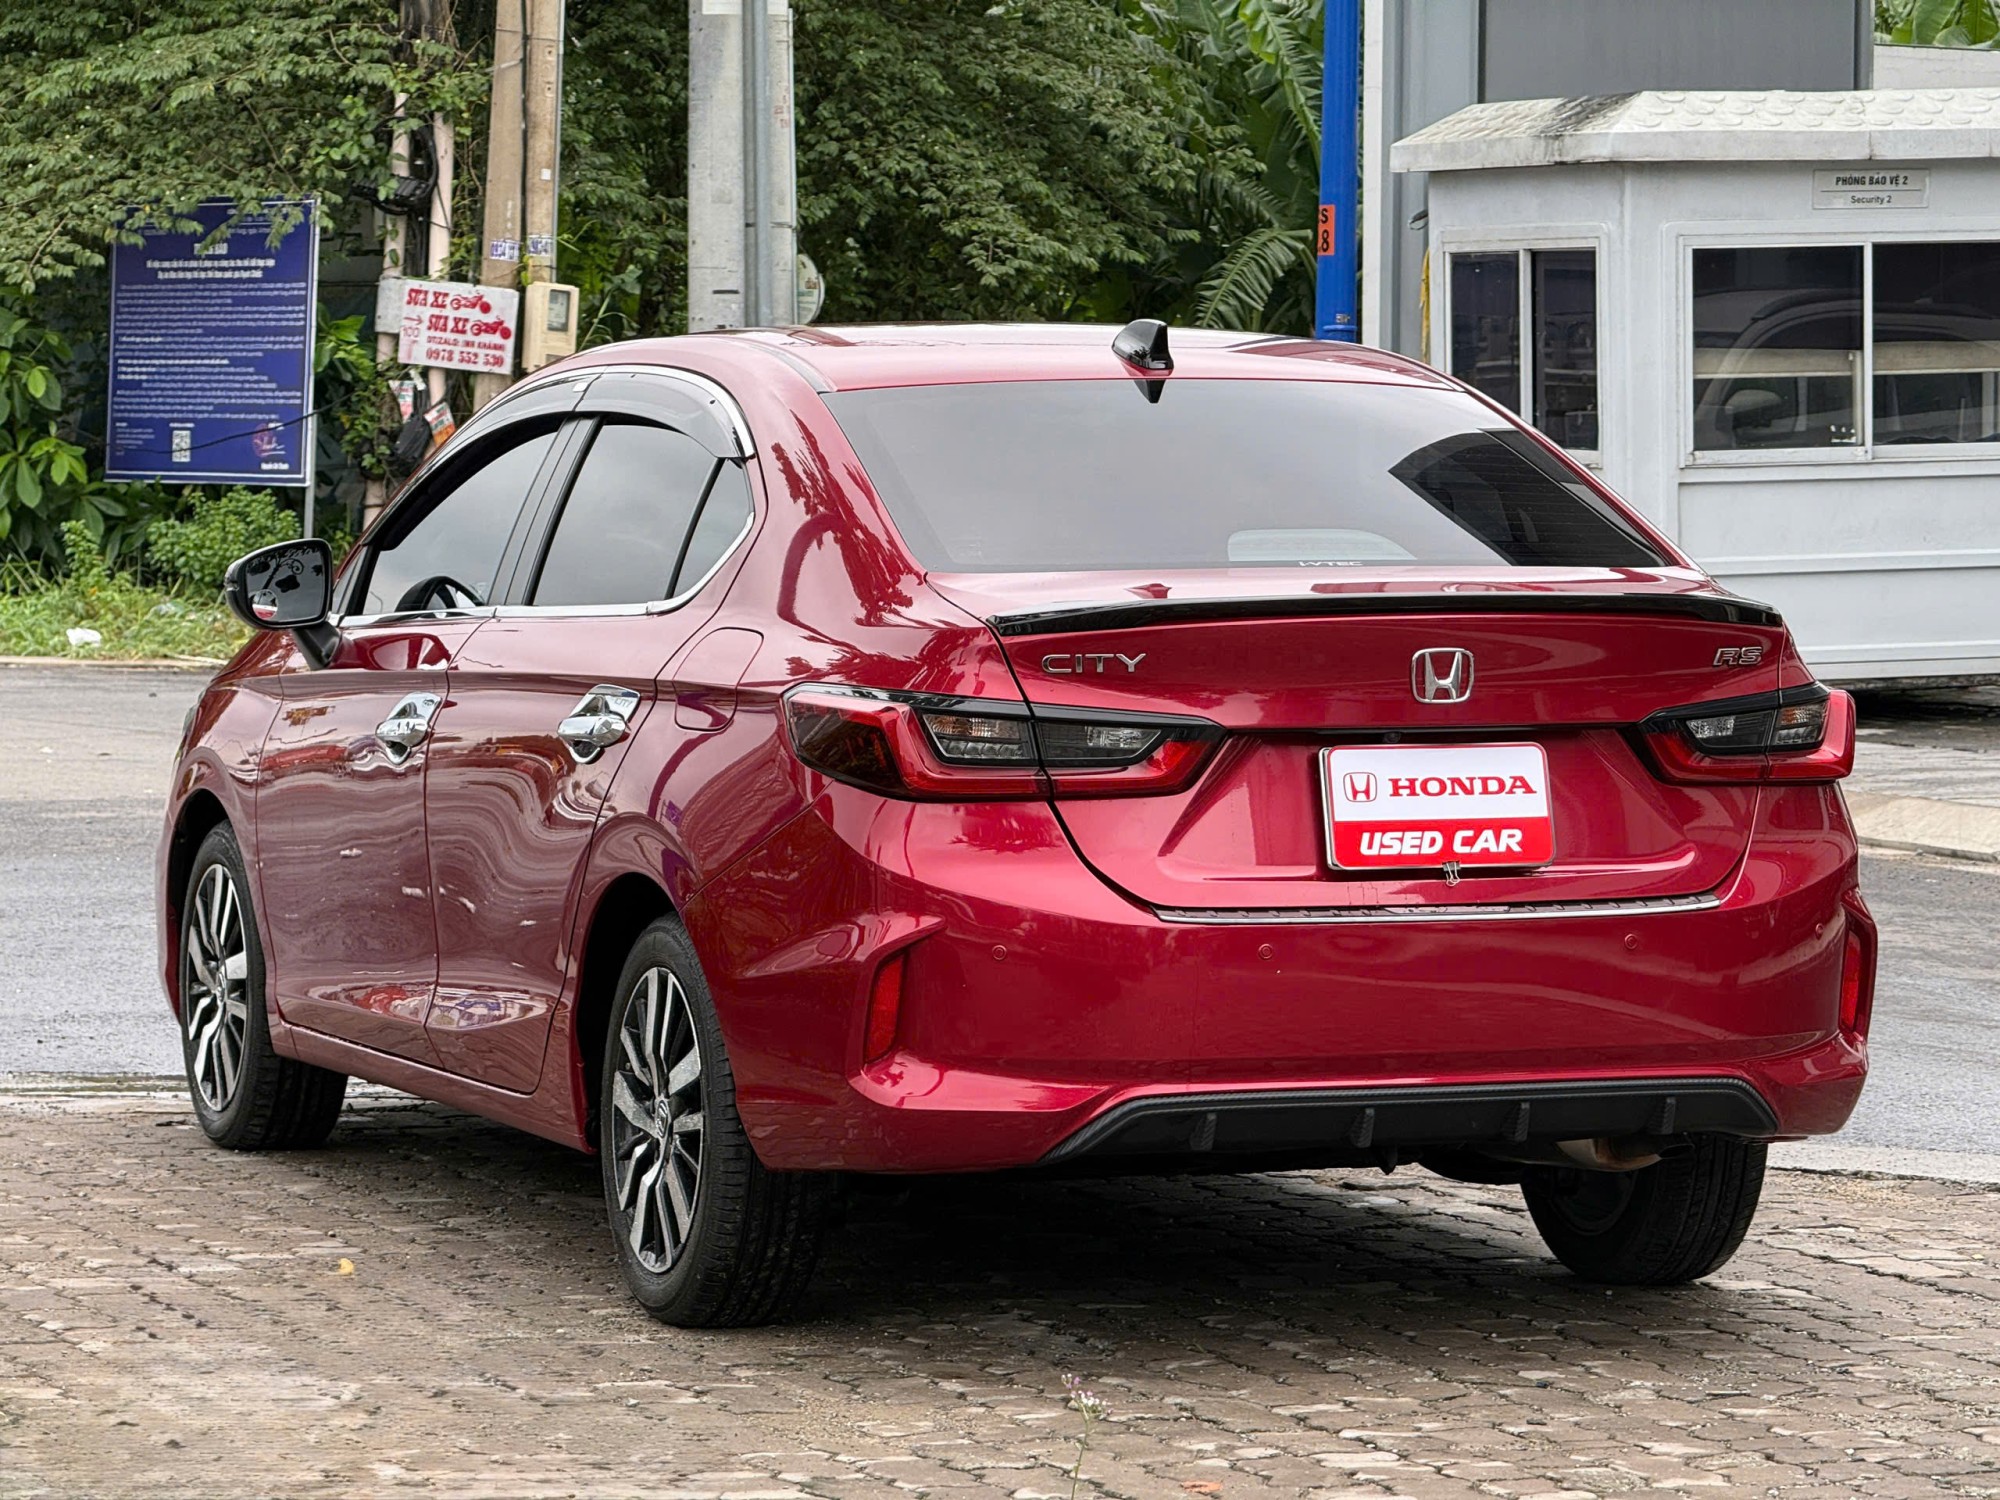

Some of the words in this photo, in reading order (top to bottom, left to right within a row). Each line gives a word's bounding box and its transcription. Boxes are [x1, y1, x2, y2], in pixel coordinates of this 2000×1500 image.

[1902, 175, 1908, 185] 2
[1850, 195, 1885, 205] Security
[1886, 195, 1892, 203] 2
[430, 291, 450, 309] XE
[450, 316, 470, 334] XE
[426, 347, 454, 362] 0978
[1041, 653, 1147, 673] CITY
[1712, 646, 1763, 666] RS
[1388, 775, 1537, 797] HONDA
[1359, 830, 1443, 856] USED
[1452, 829, 1523, 854] CAR
